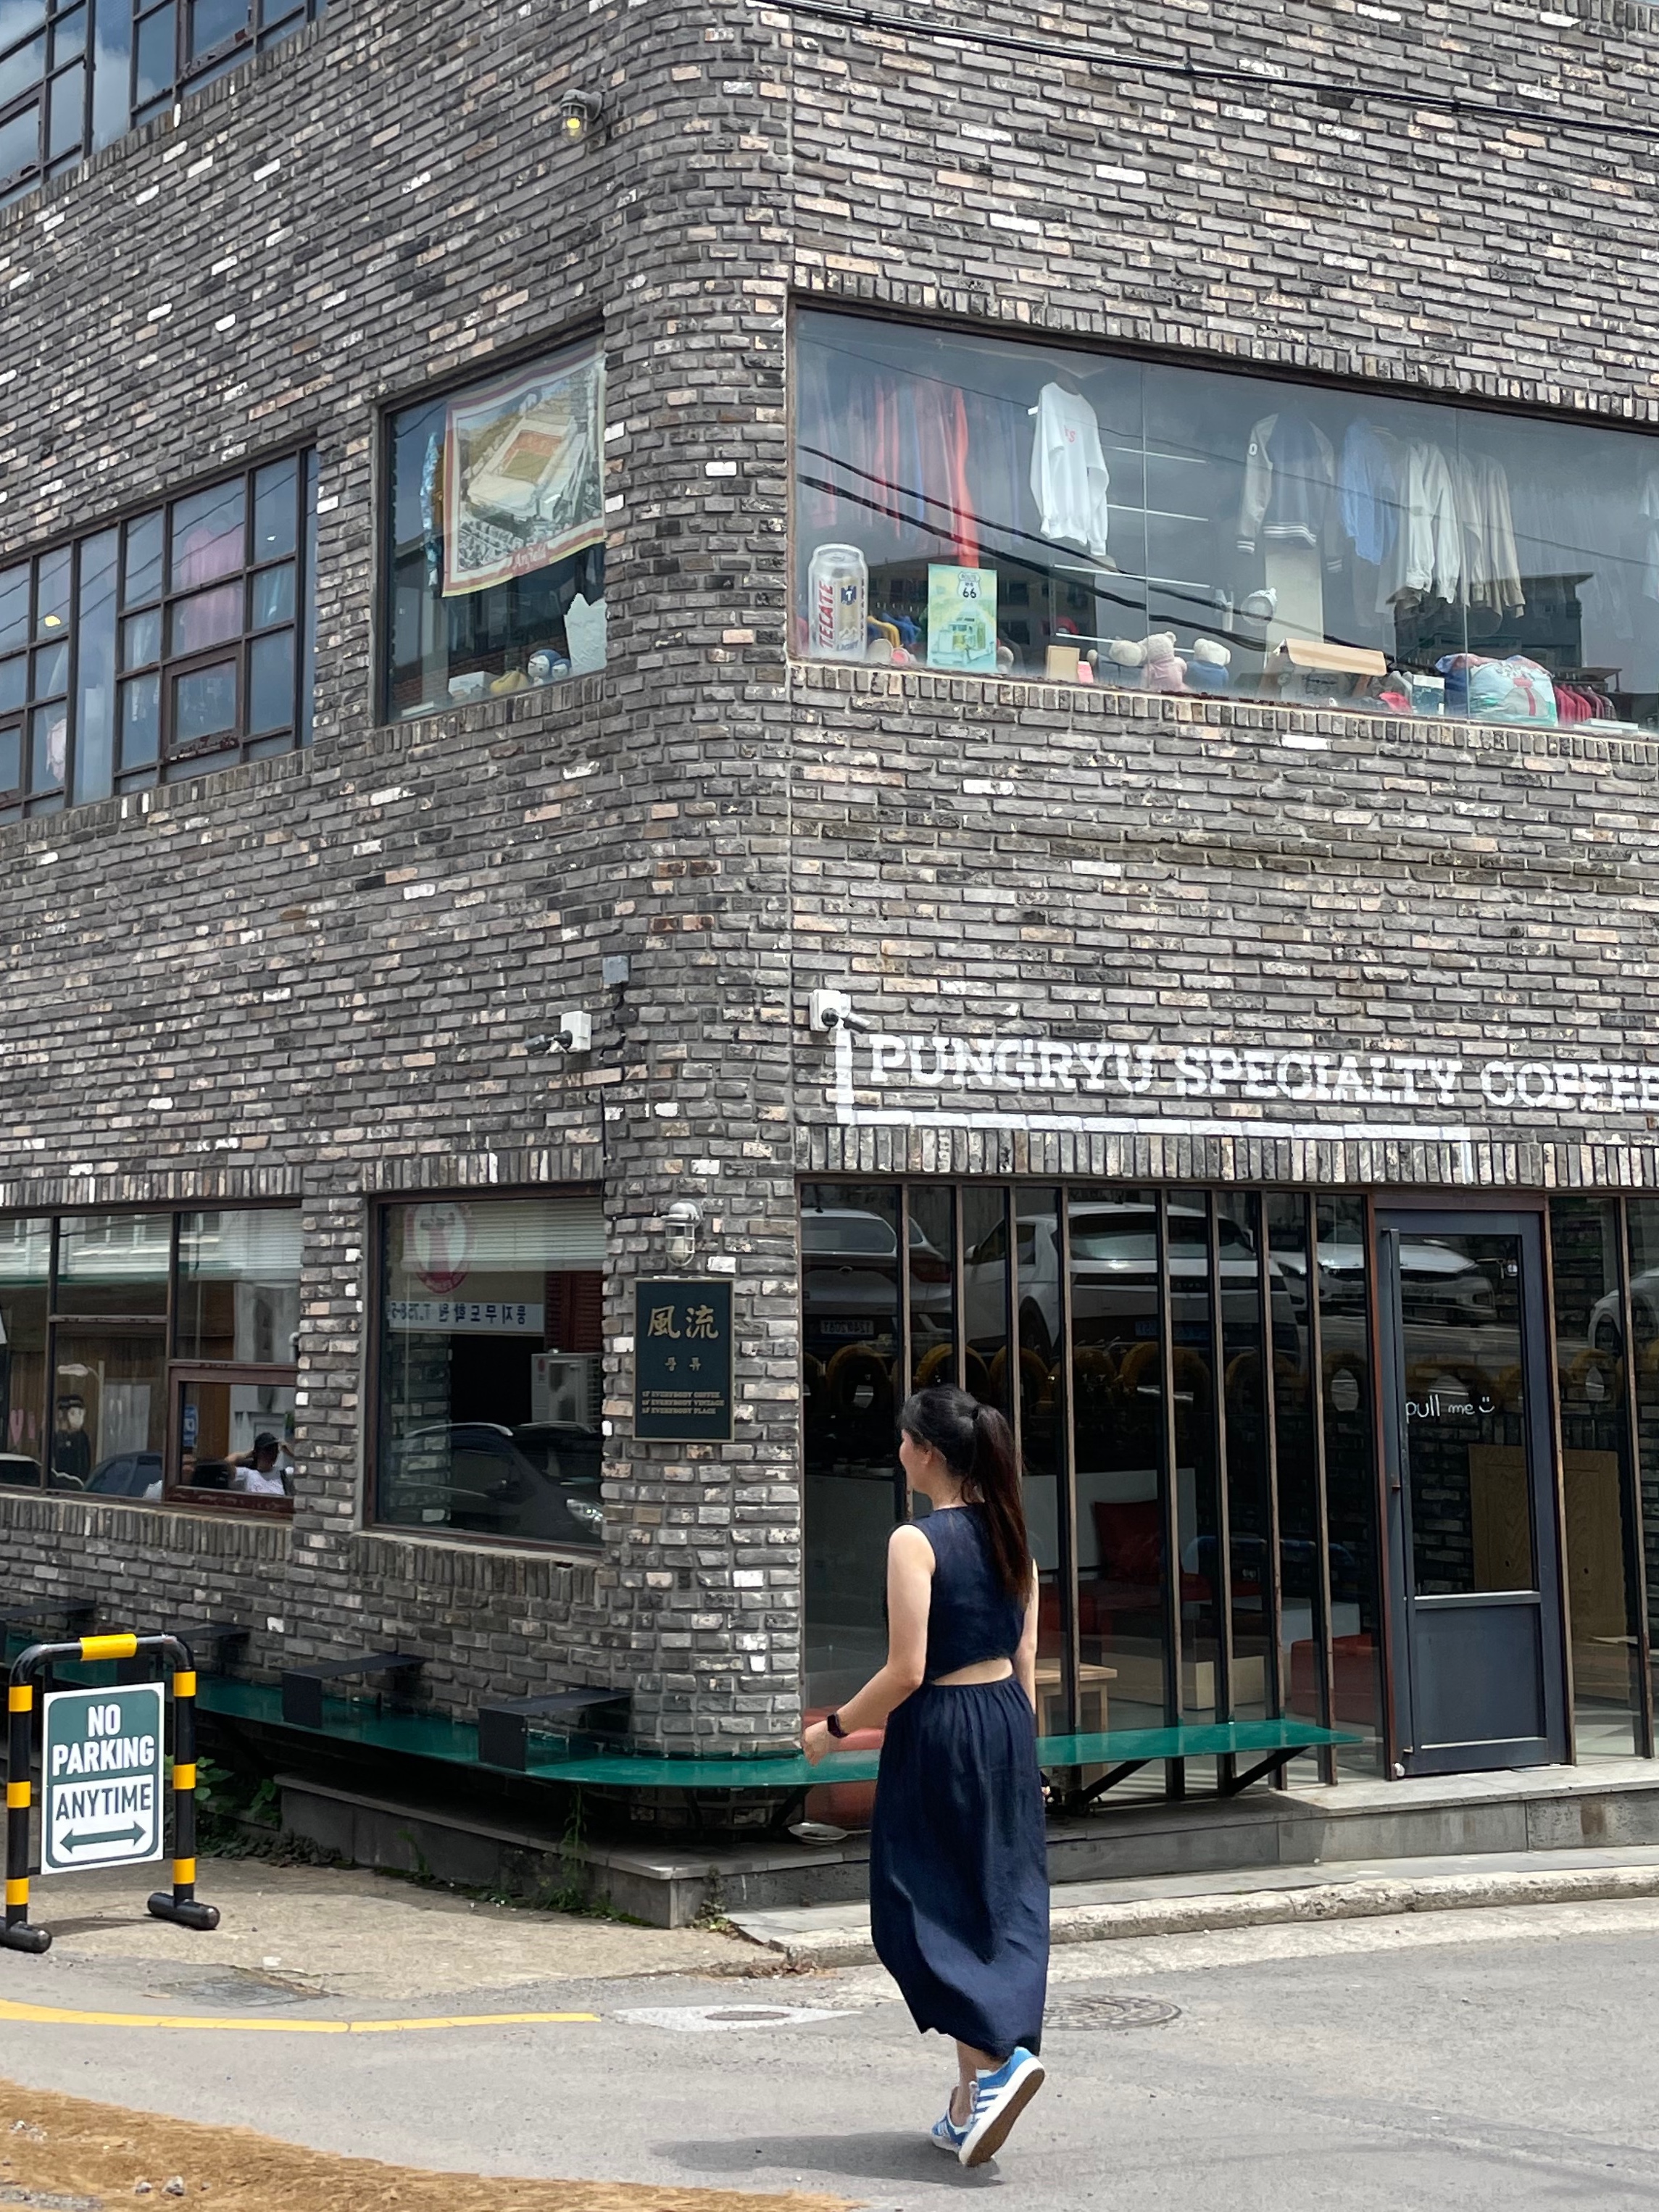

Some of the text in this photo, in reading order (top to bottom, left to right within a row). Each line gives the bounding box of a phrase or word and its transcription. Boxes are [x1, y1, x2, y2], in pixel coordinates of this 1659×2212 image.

[962, 588, 976, 598] 66
[819, 581, 833, 648] TECATE
[870, 1034, 1659, 1112] PUNGRYU SPECIALTY COFFEE
[647, 1305, 719, 1339] 風流
[1405, 1394, 1476, 1423] pull me
[88, 1704, 121, 1737] NO
[52, 1735, 154, 1776] PARKING
[55, 1783, 151, 1821] ANYTIME
